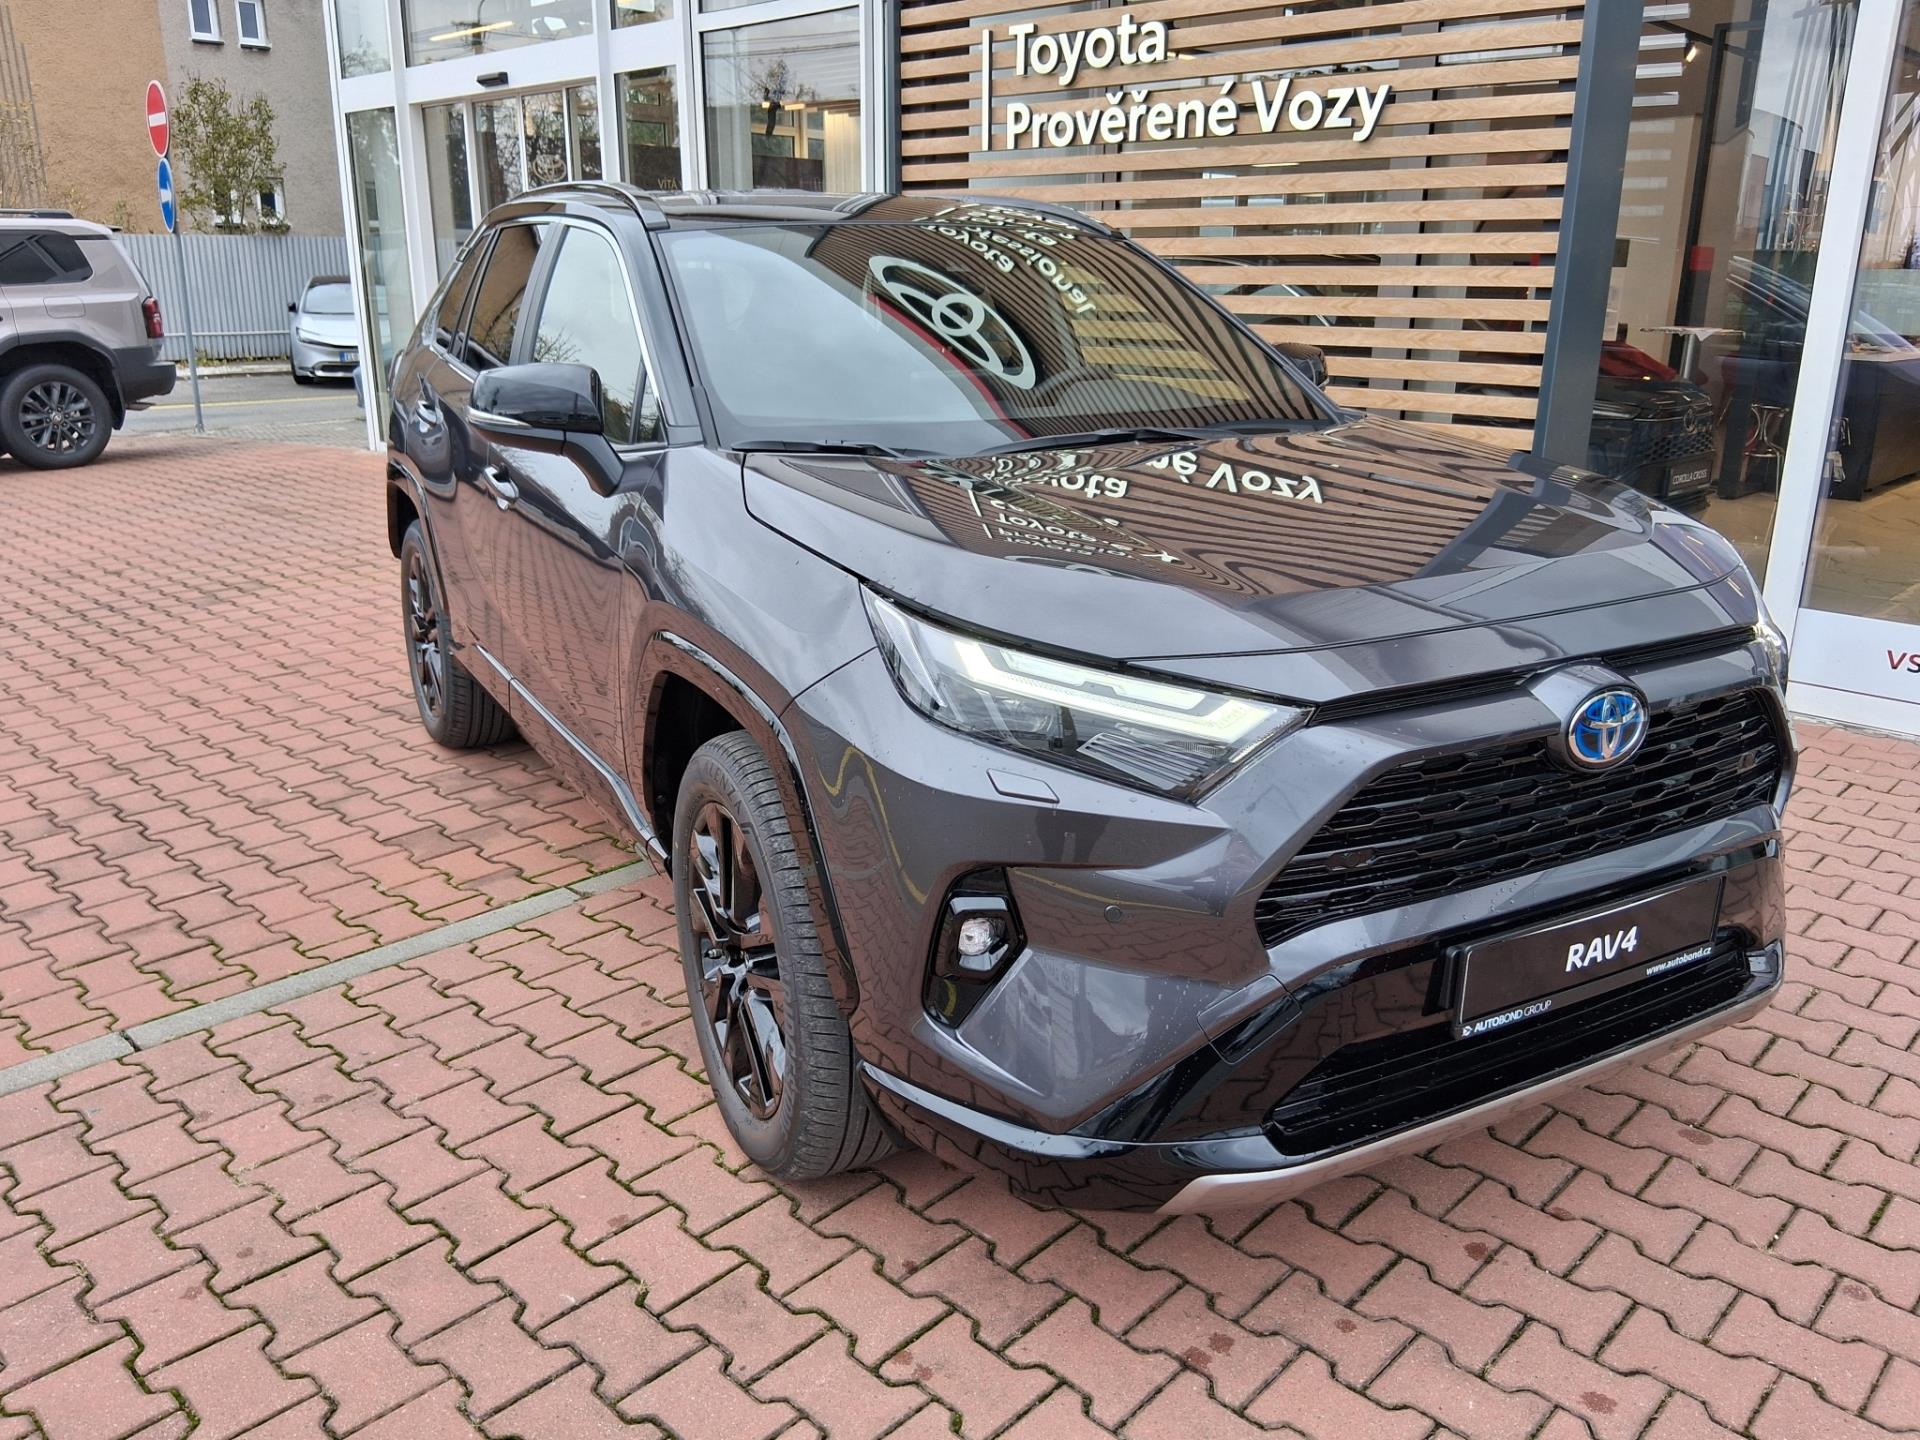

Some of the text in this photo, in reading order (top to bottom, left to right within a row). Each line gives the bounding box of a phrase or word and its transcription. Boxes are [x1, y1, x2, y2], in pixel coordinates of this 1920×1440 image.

[1008, 13, 1169, 86] Toyota
[1006, 77, 1392, 150] Prověřené Vozy
[1565, 925, 1638, 973] RAV4
[1646, 946, 1712, 976] www.autobond.cz
[1474, 1000, 1552, 1032] AUTOBOND GROUP
